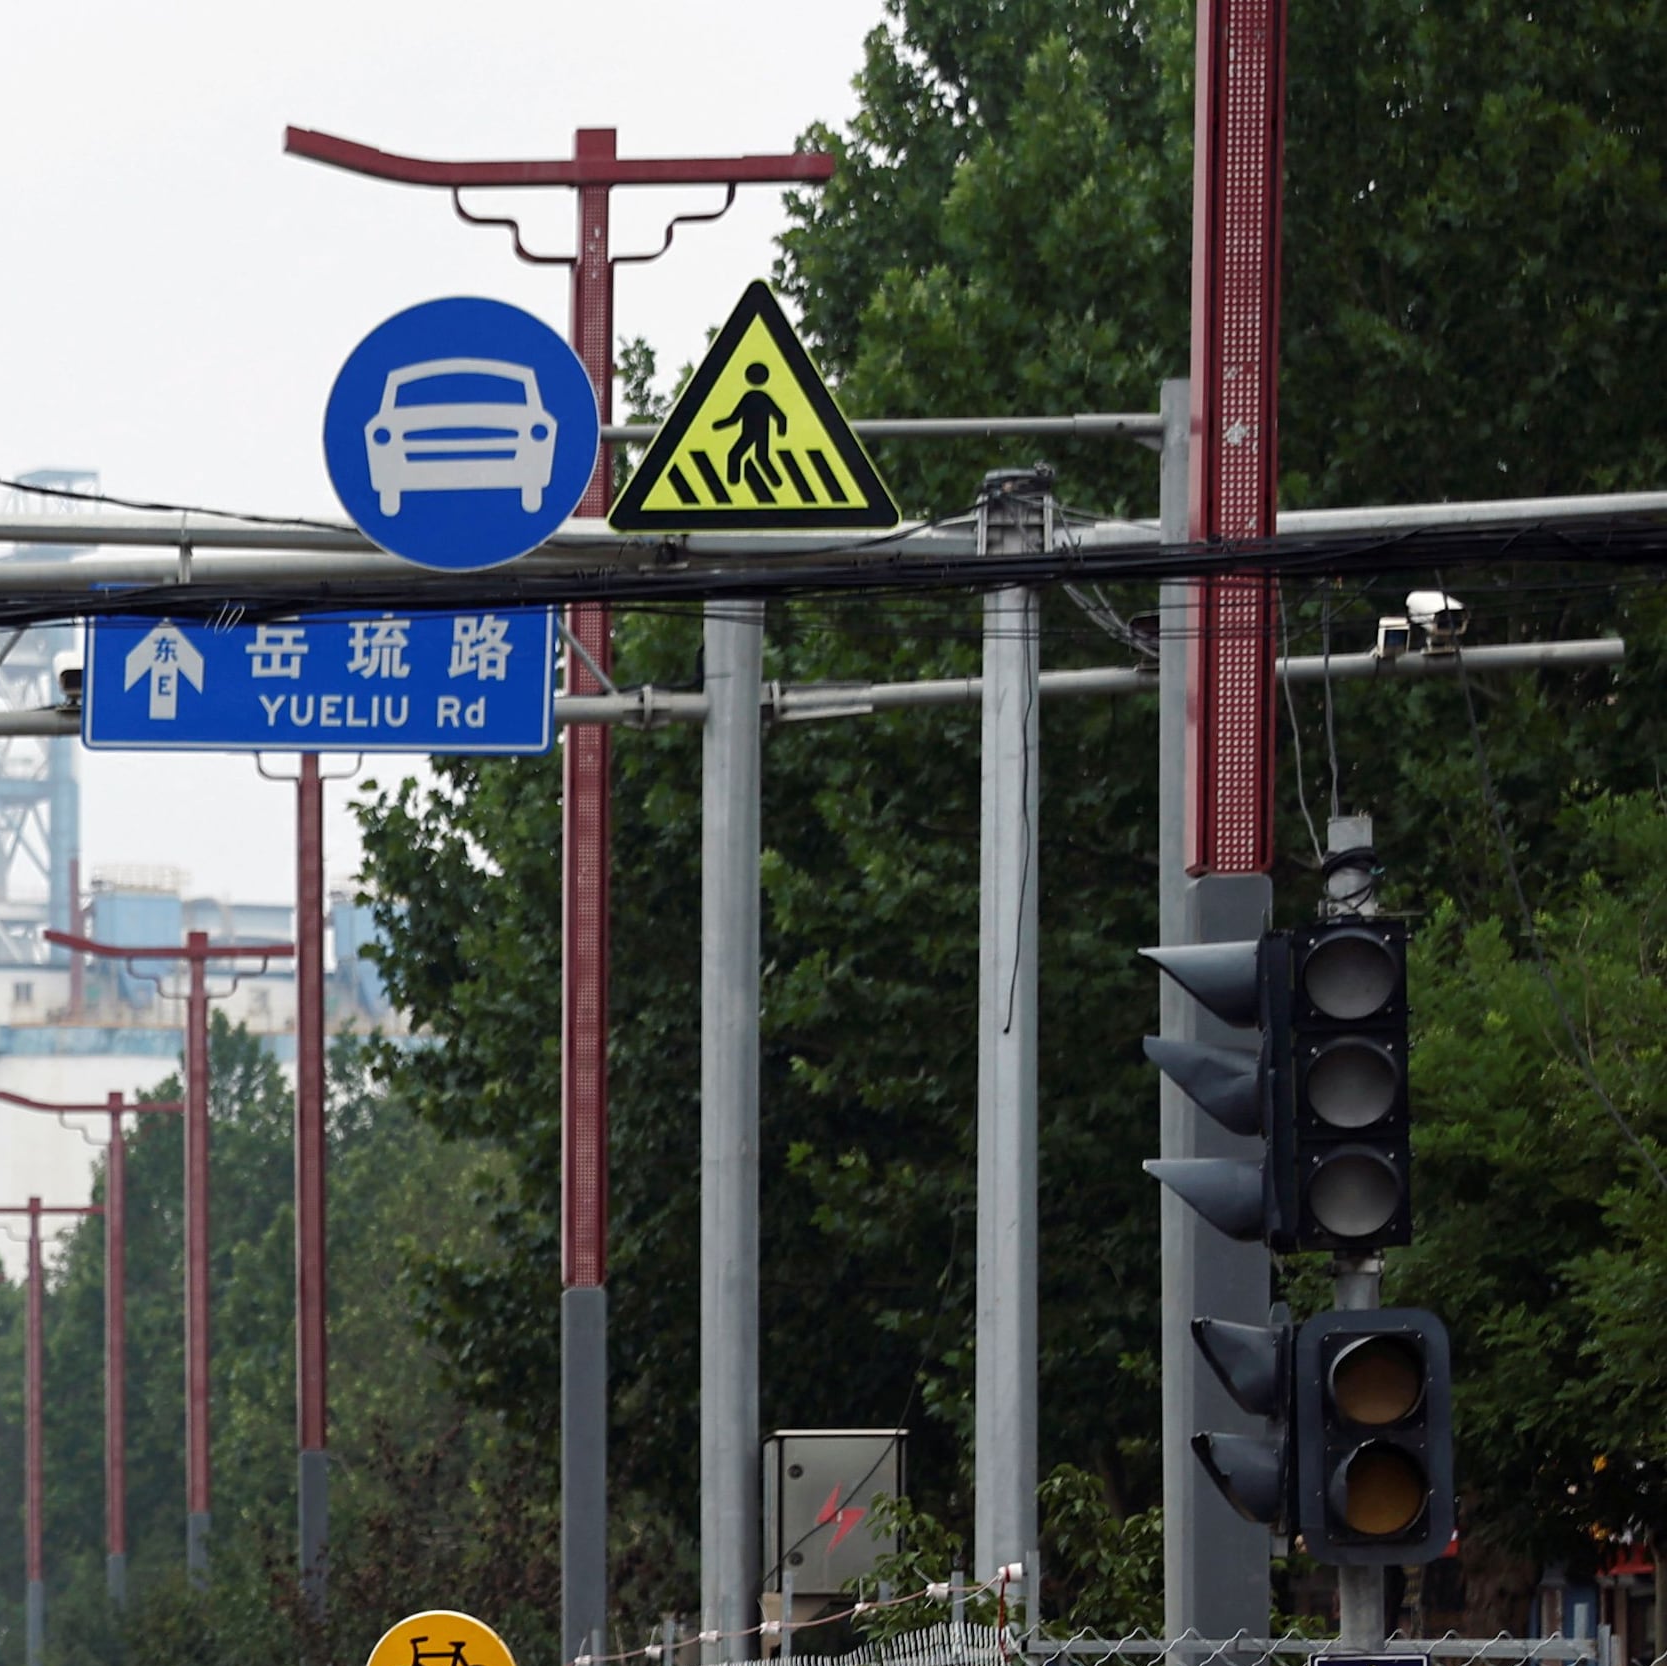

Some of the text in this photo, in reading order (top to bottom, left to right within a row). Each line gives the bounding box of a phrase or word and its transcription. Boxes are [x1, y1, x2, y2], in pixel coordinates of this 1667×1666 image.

[153, 636, 178, 664] 东
[245, 613, 513, 681] 岳琉路
[158, 675, 171, 696] E
[259, 694, 486, 728] YUELIU Rd
